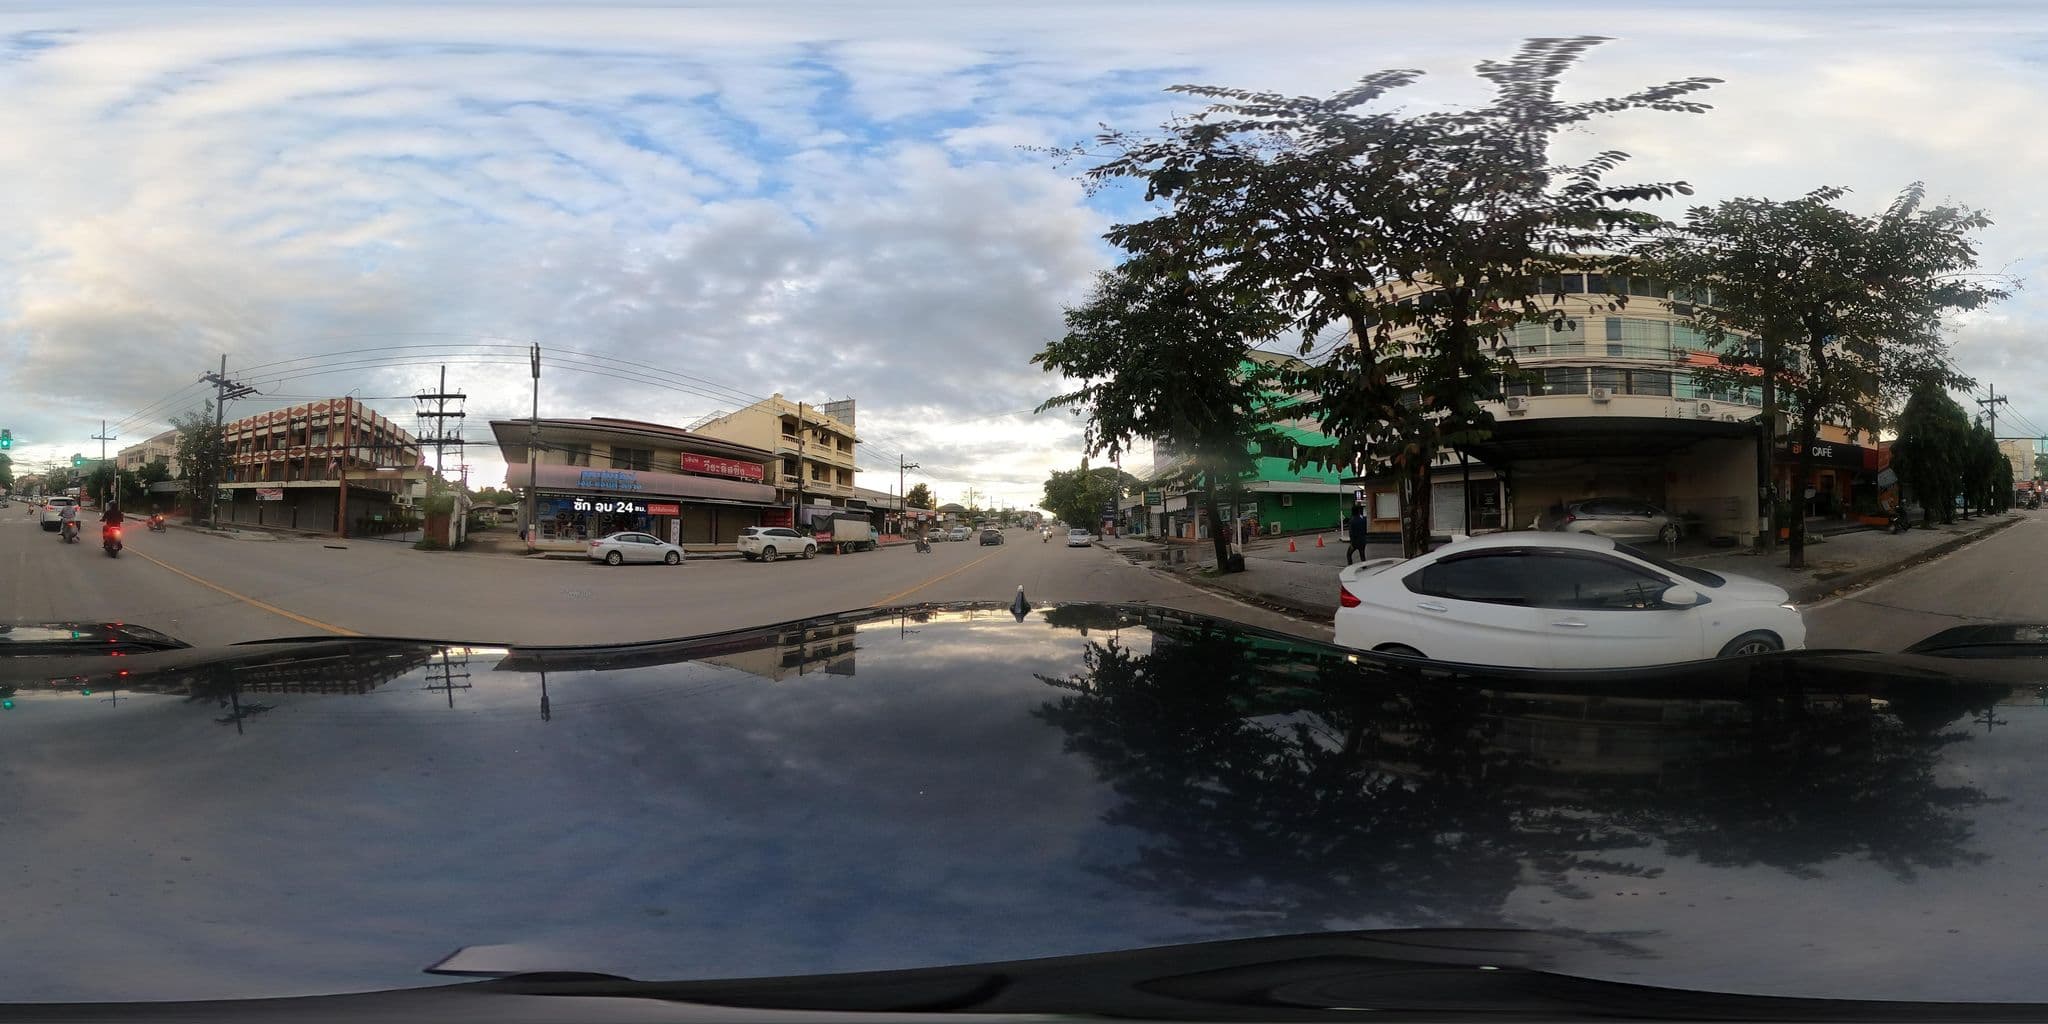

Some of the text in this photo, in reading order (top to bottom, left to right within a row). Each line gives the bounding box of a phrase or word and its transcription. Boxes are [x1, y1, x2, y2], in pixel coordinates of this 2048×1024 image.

[1812, 445, 1833, 458] CAFÉ
[573, 497, 591, 511] ซัก
[595, 501, 613, 513] อบ
[616, 501, 633, 513] 24
